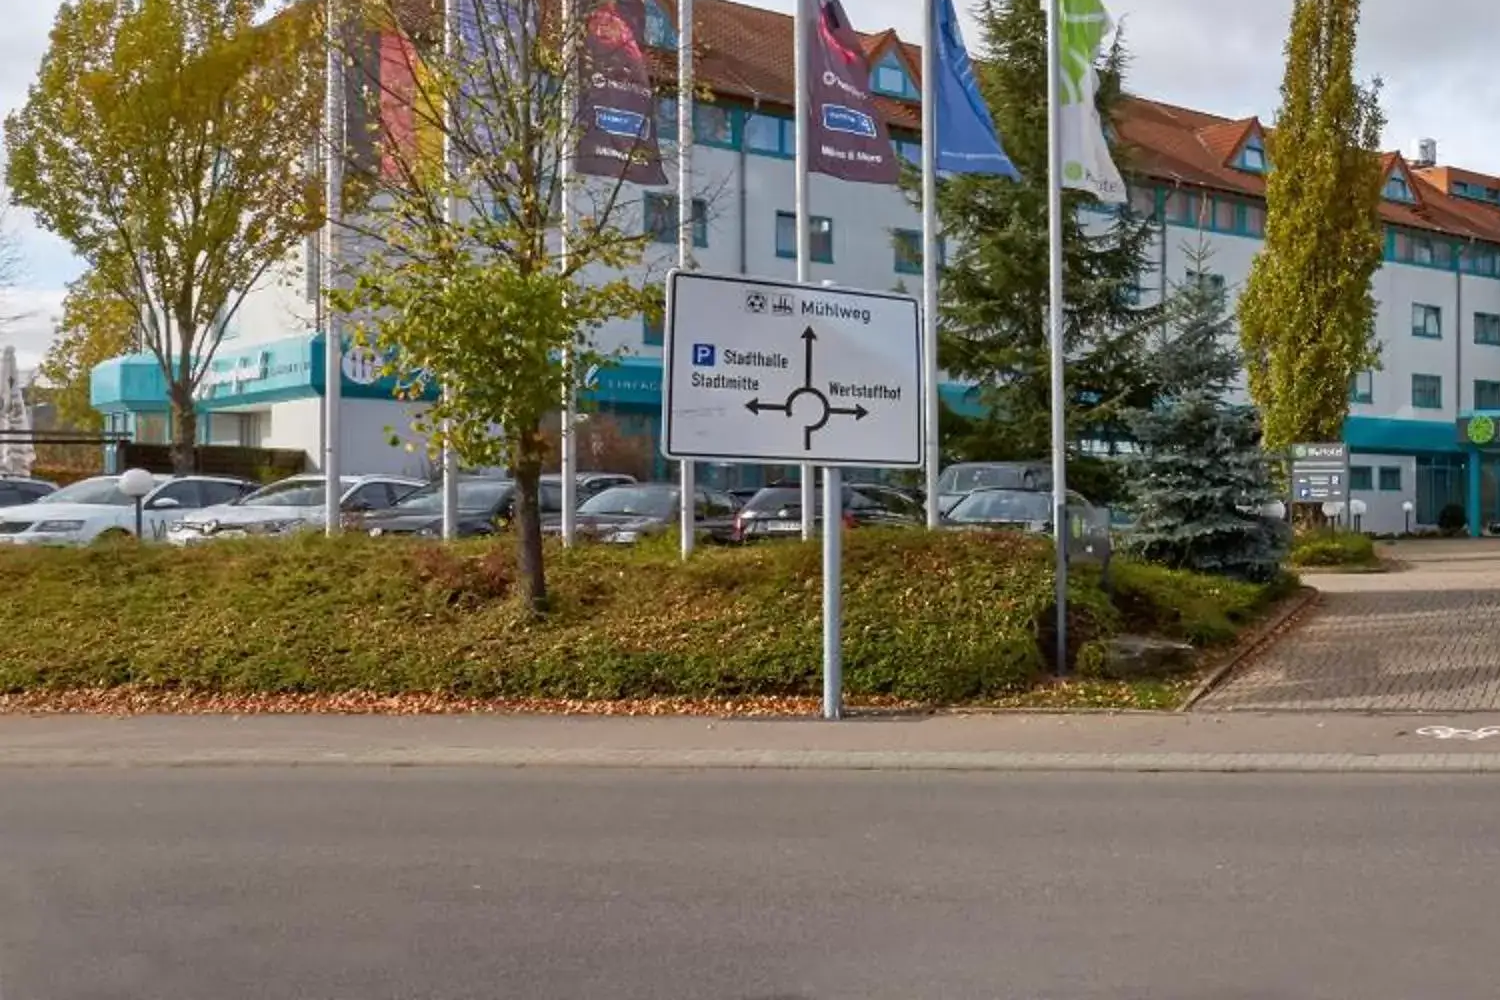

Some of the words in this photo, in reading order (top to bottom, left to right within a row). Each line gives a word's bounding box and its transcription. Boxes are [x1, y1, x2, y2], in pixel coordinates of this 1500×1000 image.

[801, 300, 871, 323] Mühlweg
[697, 348, 710, 363] P
[724, 349, 789, 369] Stadthalle
[692, 372, 760, 391] Stadtmitte
[829, 382, 902, 400] Wertstoffhof
